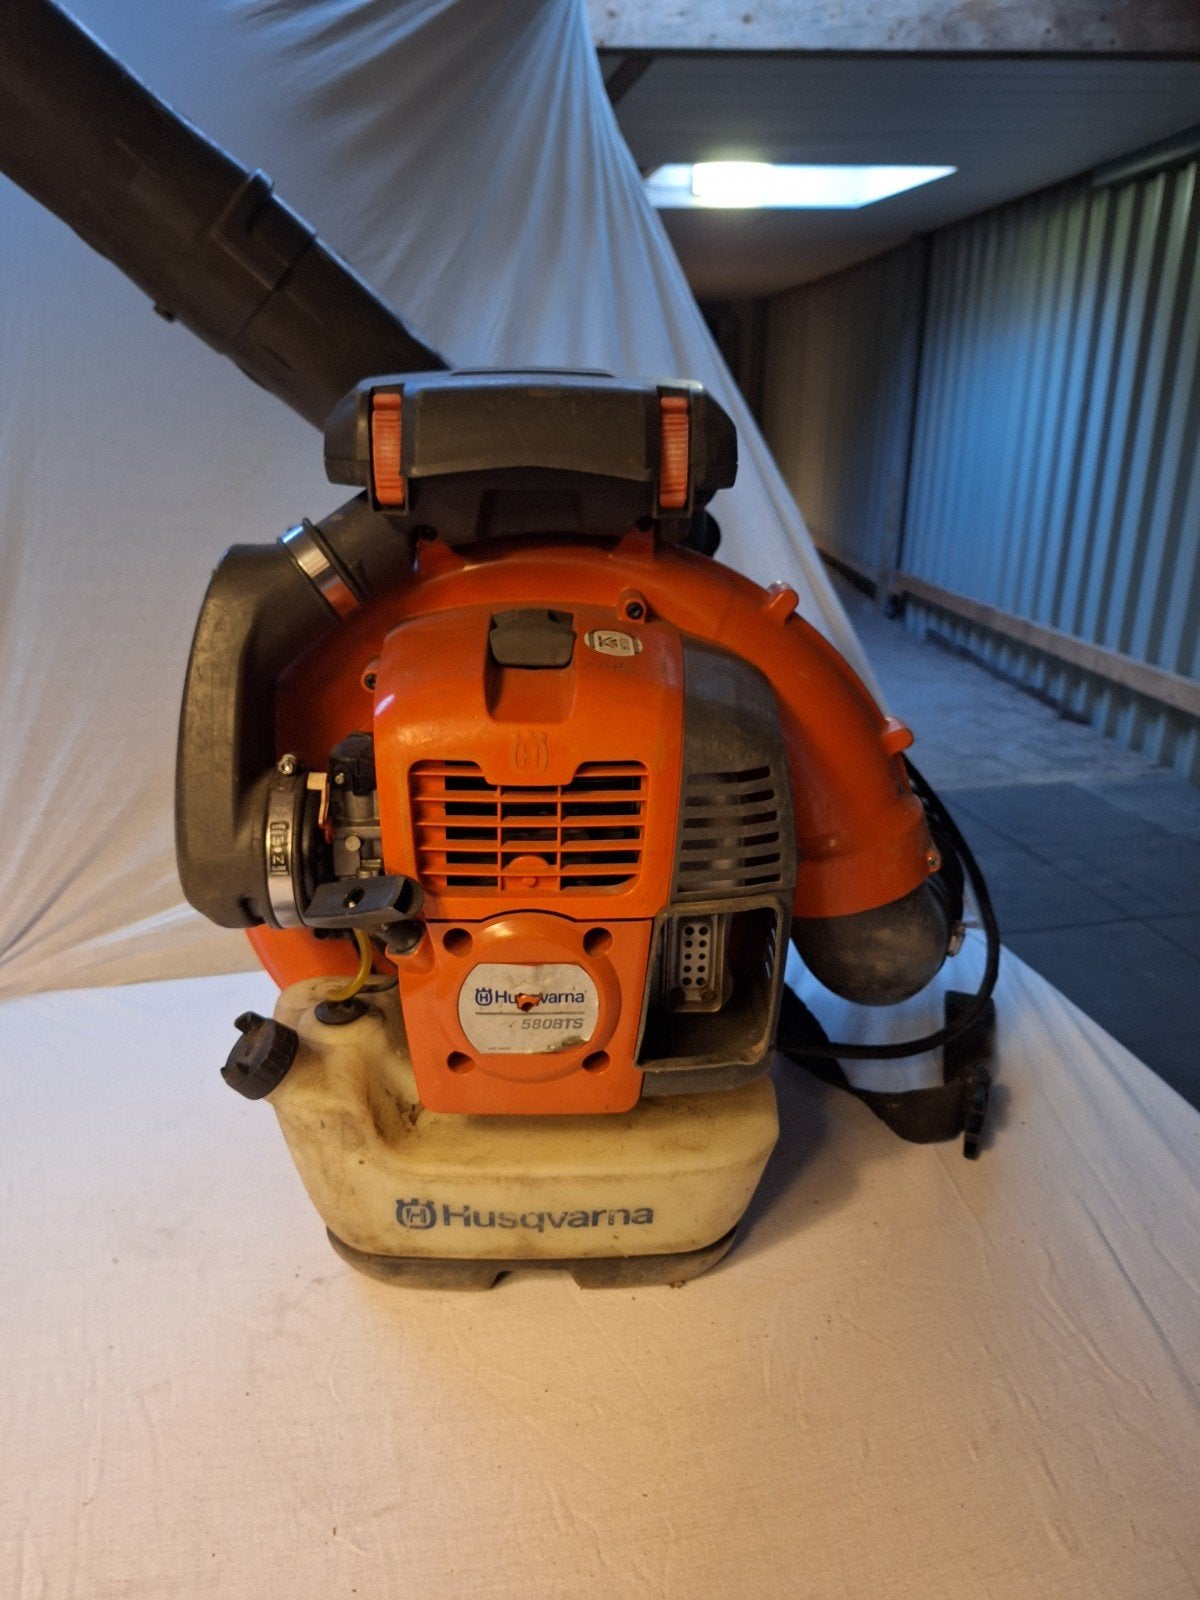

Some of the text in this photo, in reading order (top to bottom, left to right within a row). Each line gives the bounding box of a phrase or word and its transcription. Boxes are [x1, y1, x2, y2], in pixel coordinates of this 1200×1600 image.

[495, 990, 585, 1006] Huvarna
[521, 1018, 584, 1030] 580BTS
[442, 1203, 654, 1233] Husqvarna
